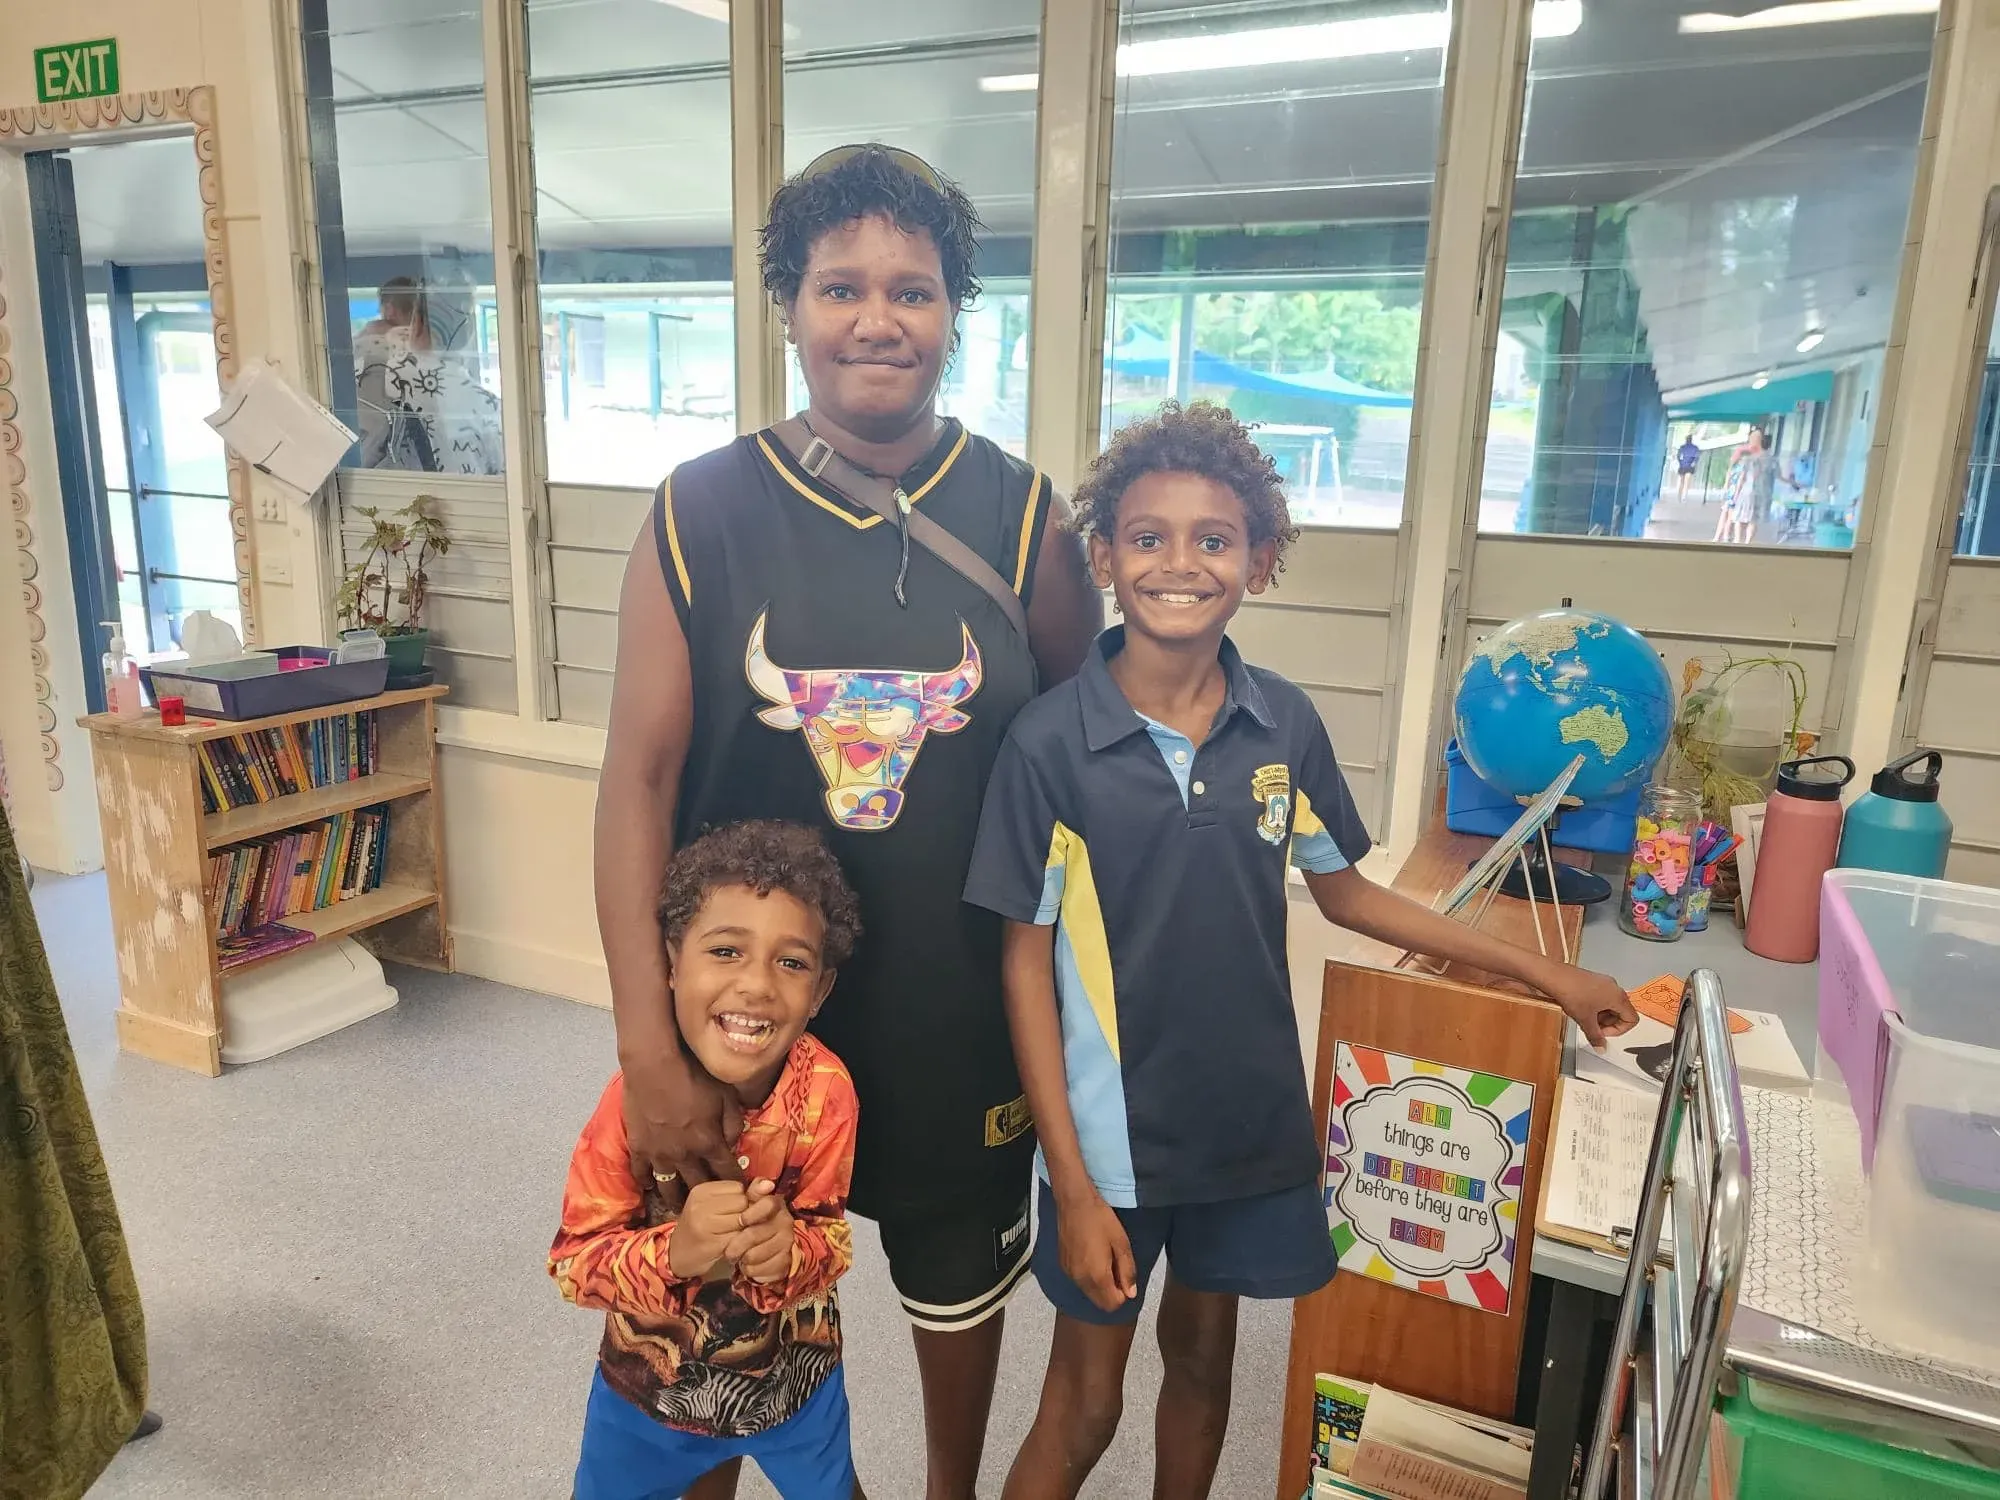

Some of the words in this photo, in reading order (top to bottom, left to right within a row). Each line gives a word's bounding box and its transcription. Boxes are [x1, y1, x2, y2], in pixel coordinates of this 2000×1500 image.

[43, 45, 110, 97] EXIT
[1409, 1103, 1449, 1127] ALL
[1384, 1121, 1434, 1156] things
[1441, 1141, 1470, 1161] are
[1356, 1173, 1409, 1205] before
[1416, 1189, 1452, 1223] they
[1458, 1205, 1488, 1226] are
[1366, 1156, 1483, 1201] DIFFICULT
[1392, 1222, 1442, 1247] EASY
